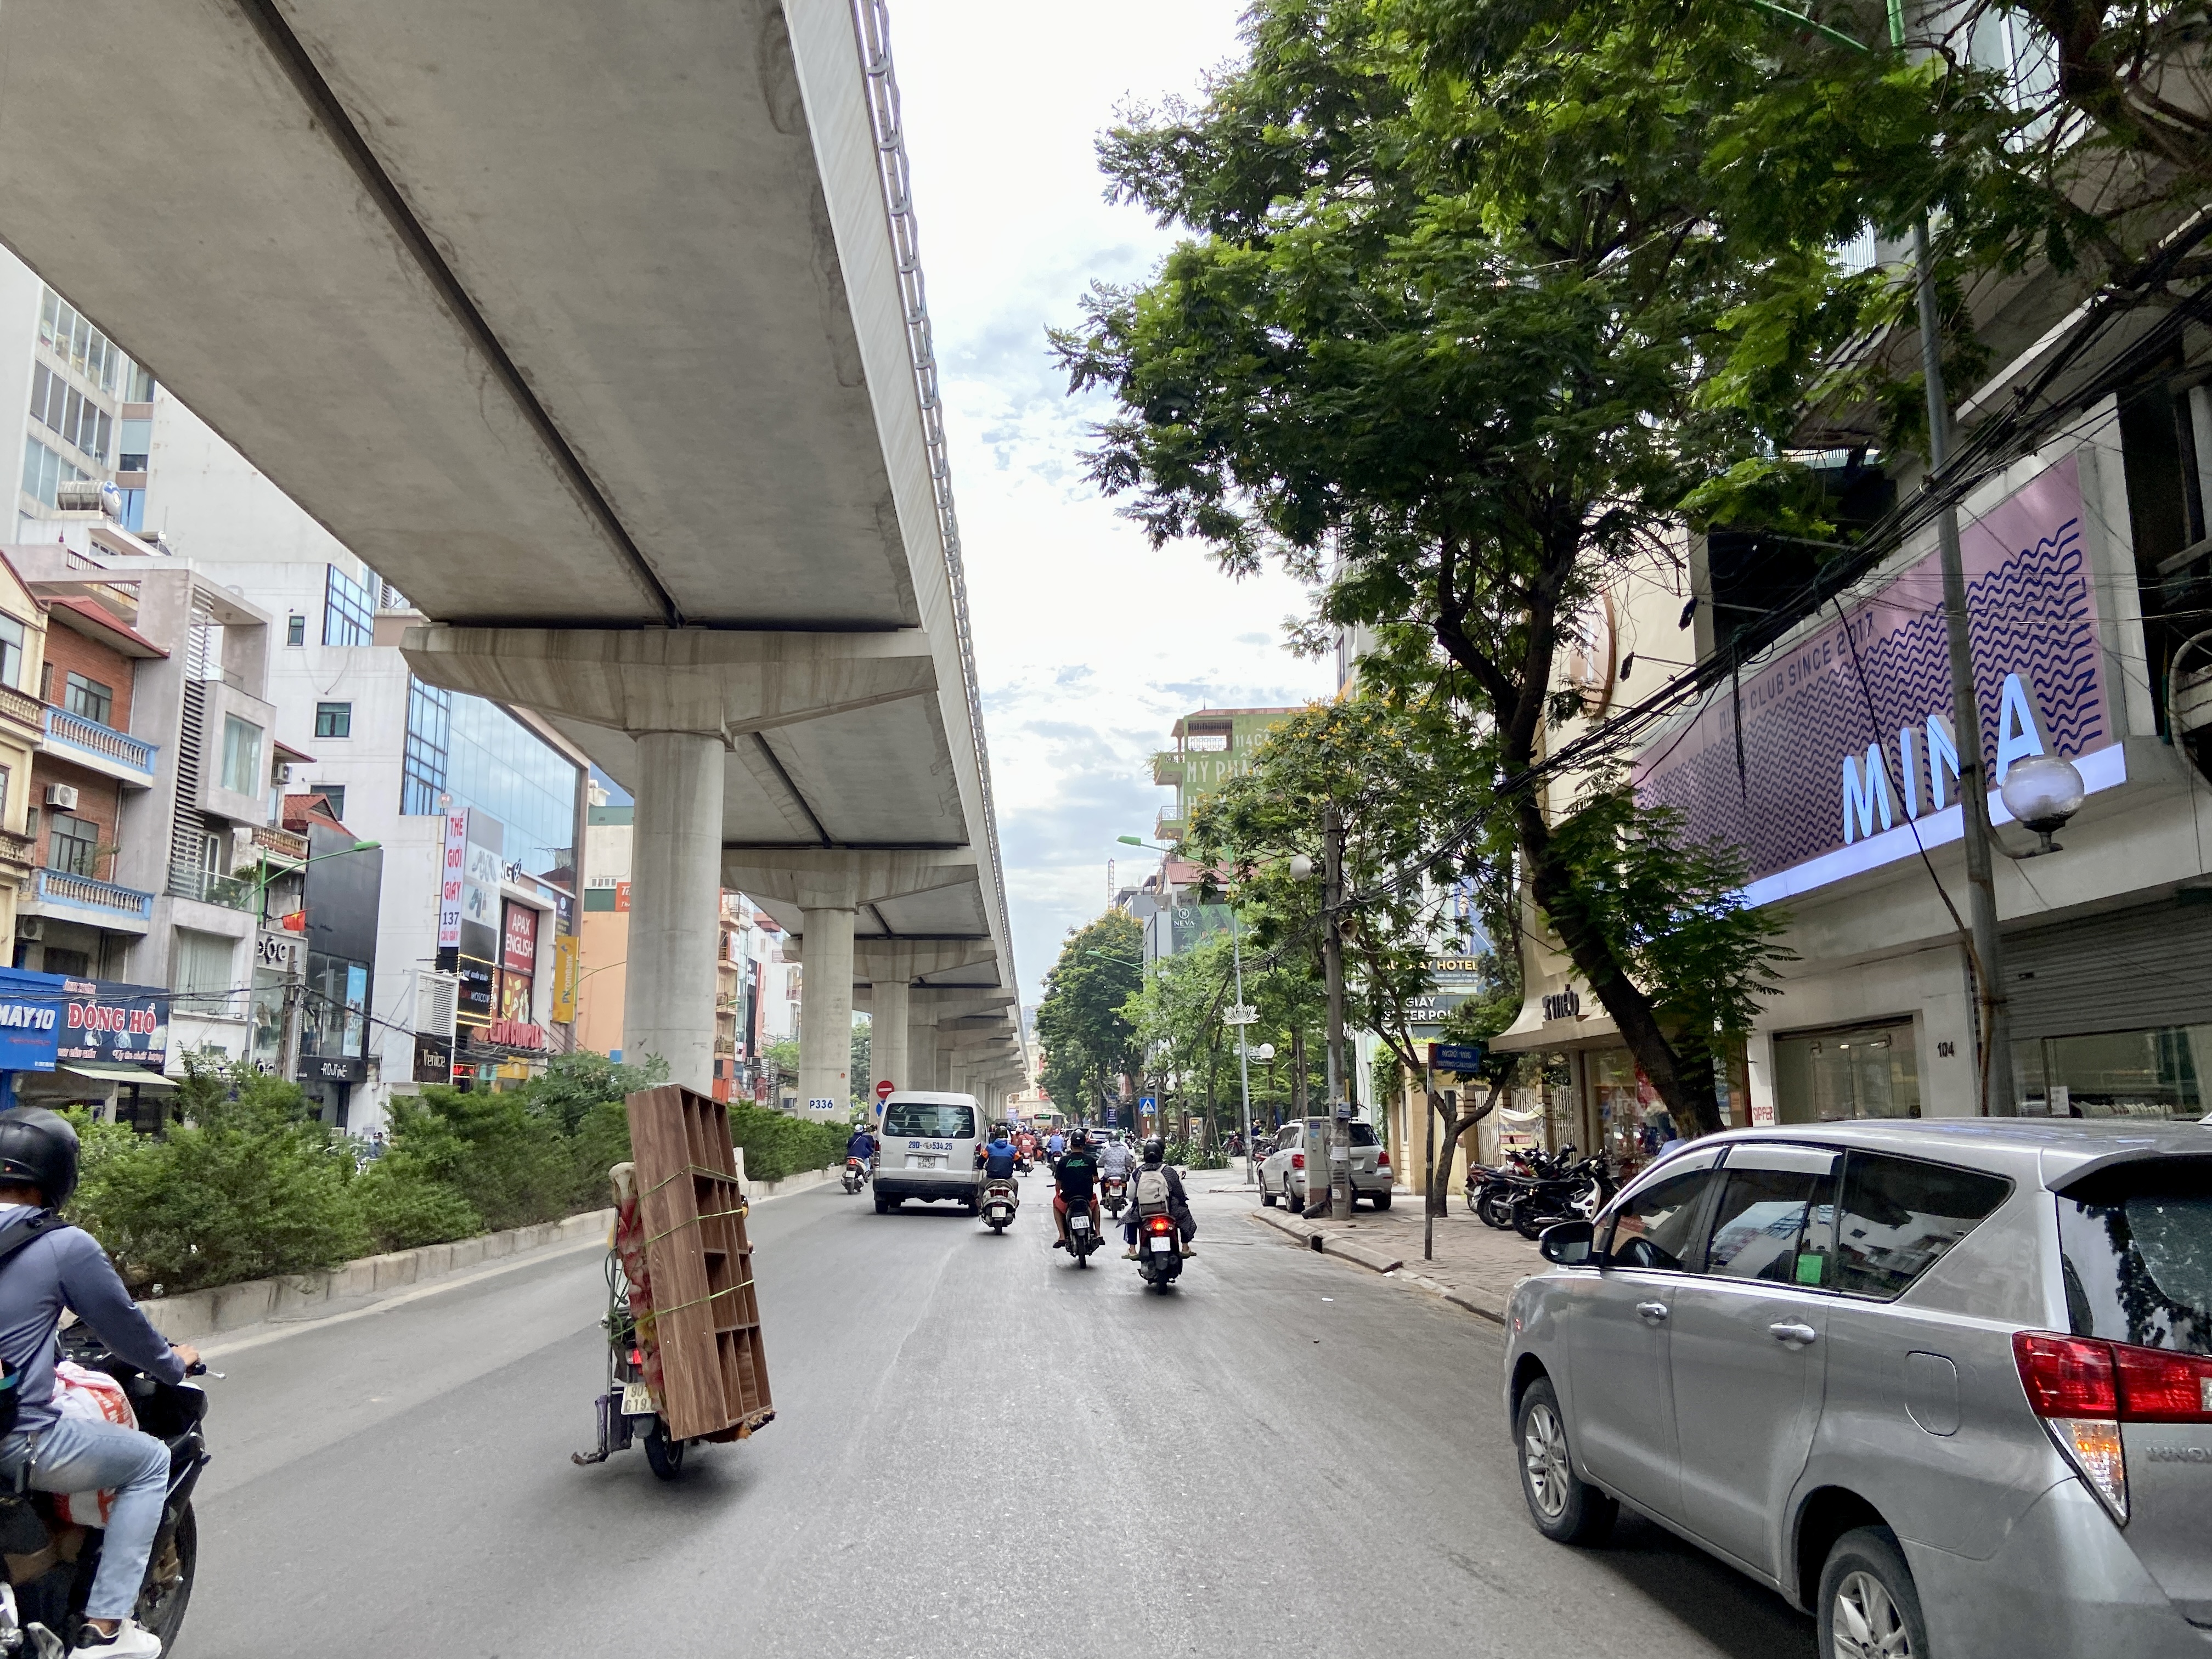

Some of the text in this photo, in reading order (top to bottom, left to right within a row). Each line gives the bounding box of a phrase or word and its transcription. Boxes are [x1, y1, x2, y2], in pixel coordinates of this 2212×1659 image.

[1750, 673, 1784, 710] CLUB
[1788, 640, 1832, 686] SINCE
[1837, 611, 1874, 657] 2017
[1186, 754, 1210, 783] MỸ
[1843, 673, 2045, 844] MINA
[450, 810, 465, 838] THẾ
[447, 844, 463, 868] GIỚI
[444, 876, 462, 902] GIÀY
[443, 911, 460, 925] 137
[512, 913, 531, 936] APAX
[505, 933, 534, 959] ENGLISH
[1437, 960, 1477, 971] HOTEL
[422, 1048, 445, 1068] Venice
[1937, 1041, 1955, 1057] 104
[810, 1099, 833, 1109] P336
[932, 1142, 953, 1150] 534.25
